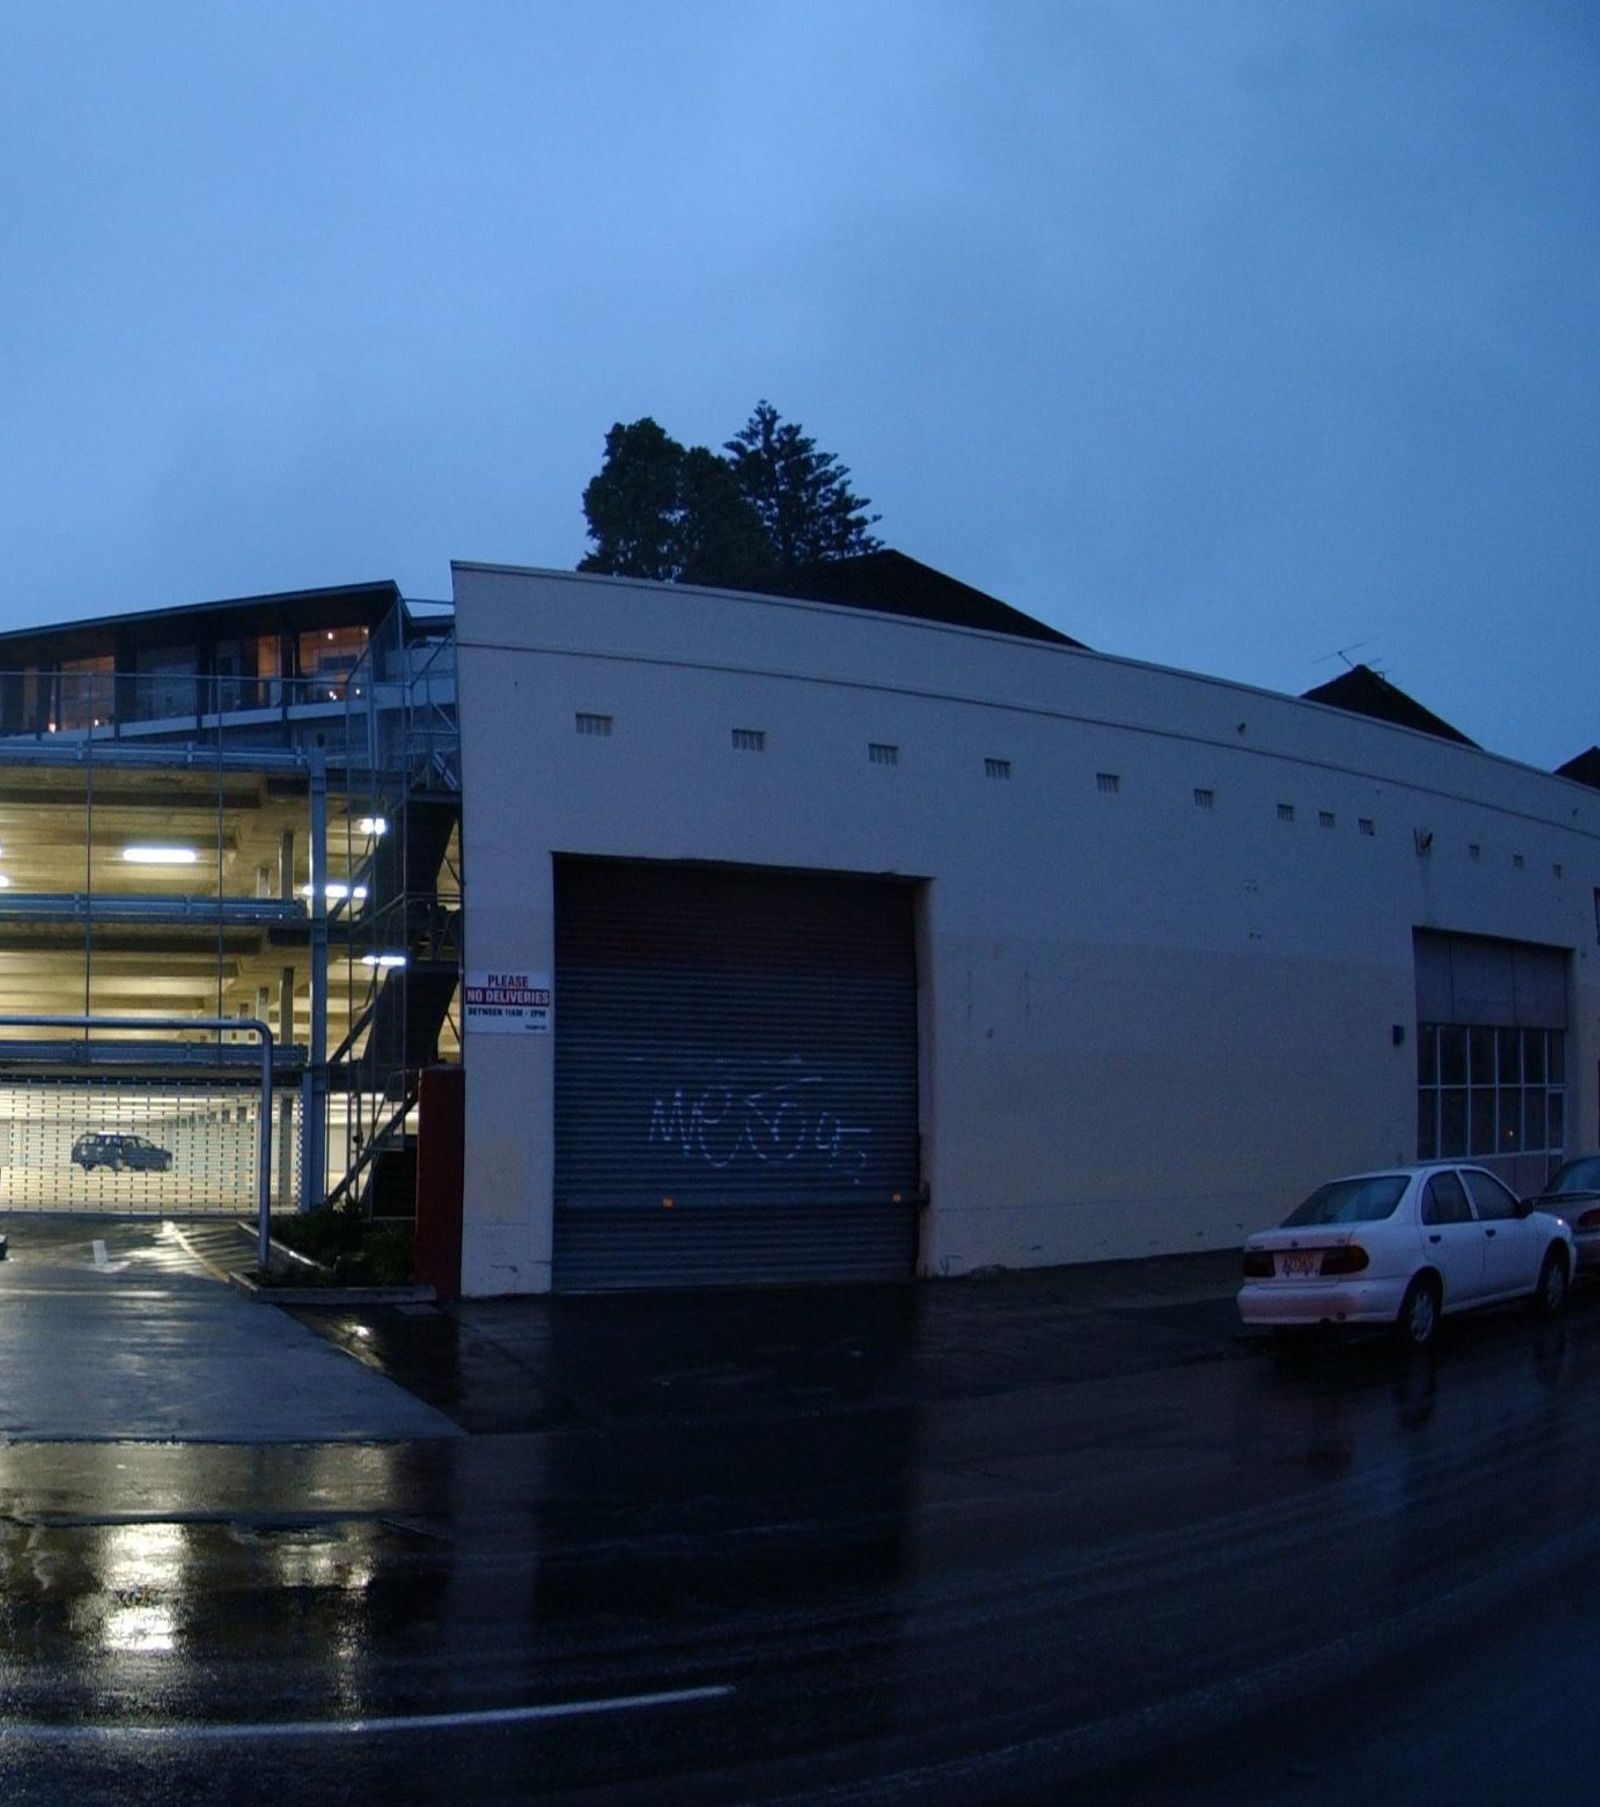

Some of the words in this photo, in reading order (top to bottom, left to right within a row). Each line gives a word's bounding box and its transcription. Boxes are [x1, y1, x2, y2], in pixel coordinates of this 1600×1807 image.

[488, 974, 528, 988] PLEASE
[467, 988, 483, 1003] NO
[485, 989, 549, 1006] DELIVERIES
[468, 1007, 503, 1017] BETWEEN
